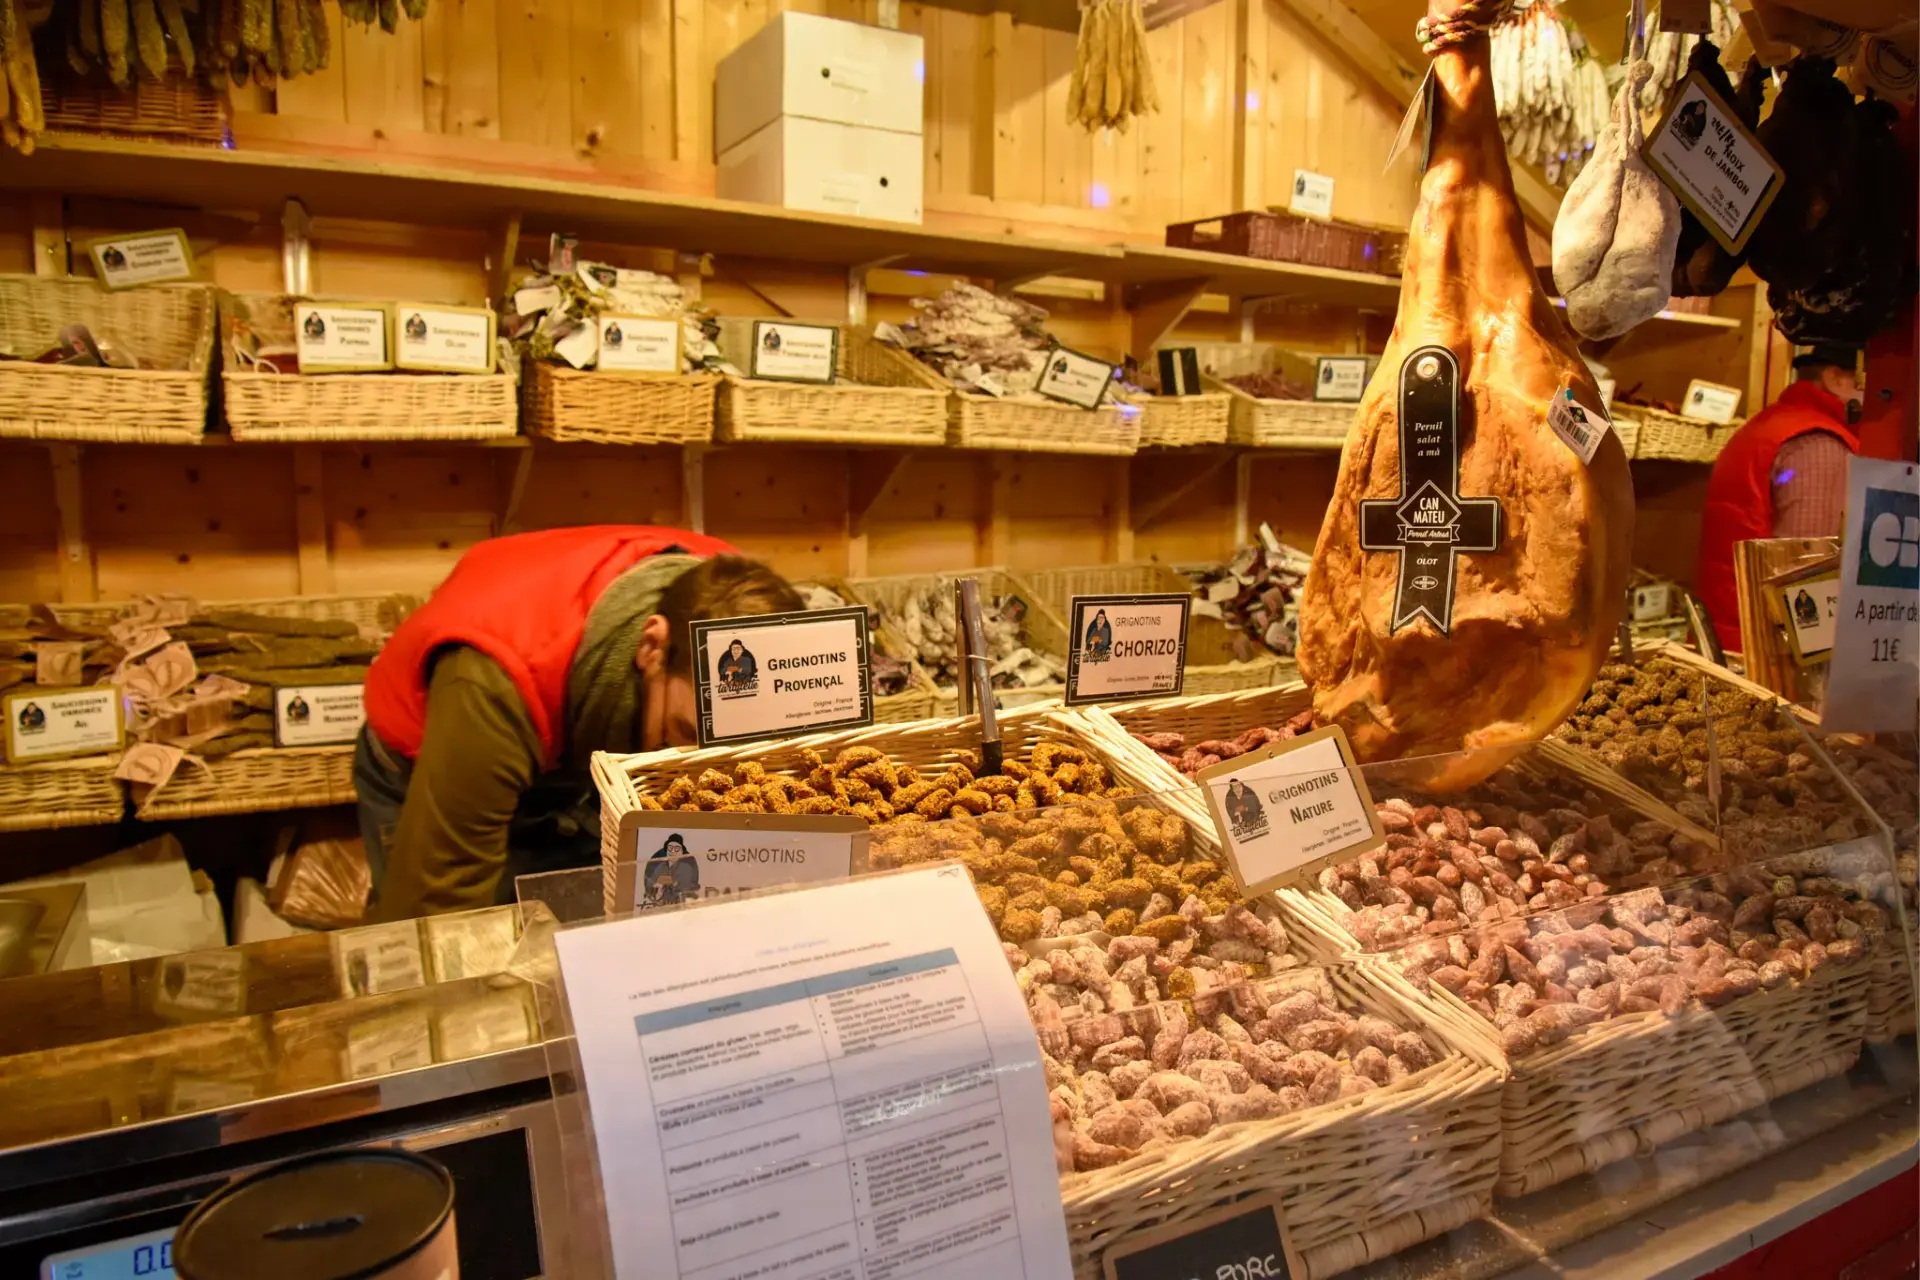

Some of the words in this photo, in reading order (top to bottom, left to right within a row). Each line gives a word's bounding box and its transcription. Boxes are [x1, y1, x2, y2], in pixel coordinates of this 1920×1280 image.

[1704, 145, 1716, 163] DE
[1716, 158, 1750, 196] JAMBON
[1723, 149, 1746, 173] NOIX
[1415, 421, 1443, 431] Pernil
[1417, 434, 1441, 444] salat
[1420, 497, 1439, 510] CAN
[1413, 511, 1445, 524] MATEU
[1115, 616, 1161, 627] GRIGNOTINS
[1868, 602, 1905, 624] partir
[1114, 639, 1176, 658] CHORIZO
[1871, 638, 1901, 662] 11€
[767, 652, 847, 671] GRIGNOTINS
[774, 675, 844, 693] PROVENÇAL
[1268, 771, 1339, 805] GRIGNOTINS
[1290, 800, 1334, 825] NATURE
[706, 848, 806, 864] GRIGNOTINS
